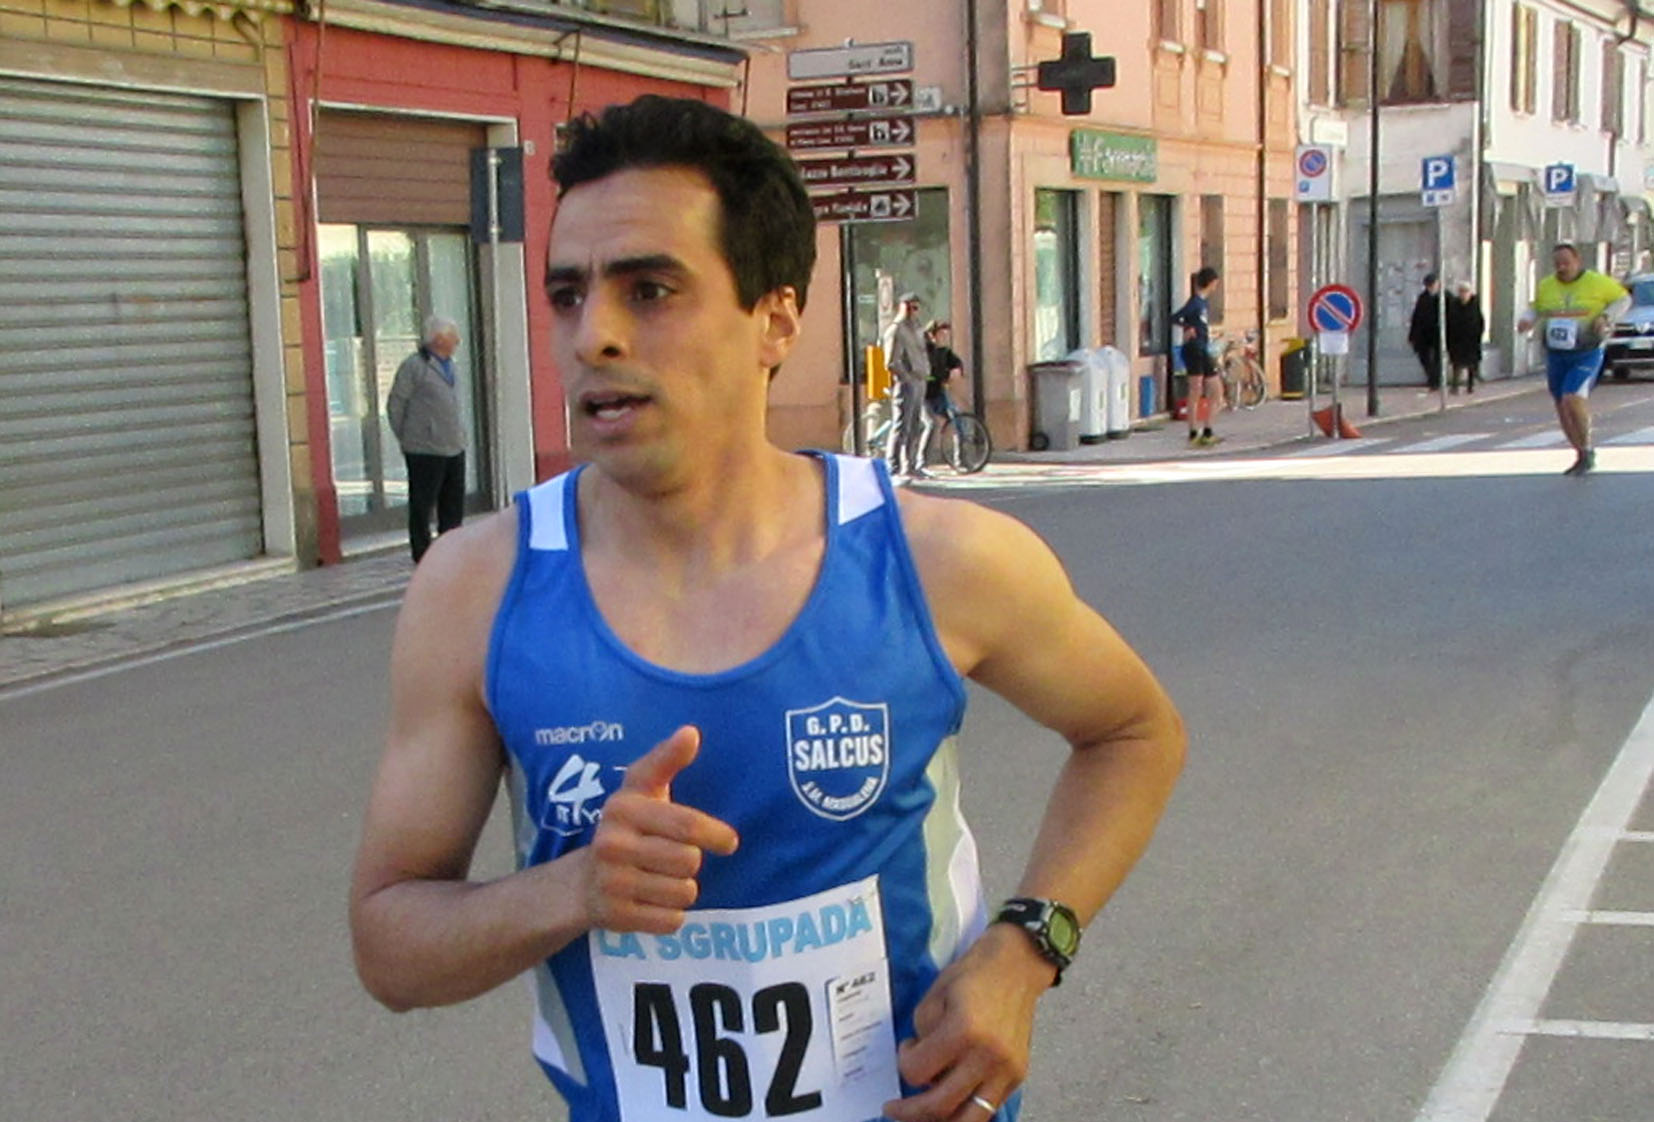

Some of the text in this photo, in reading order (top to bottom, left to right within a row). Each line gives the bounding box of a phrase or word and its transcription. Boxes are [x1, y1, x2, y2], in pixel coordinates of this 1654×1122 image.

[1428, 160, 1448, 187] P
[1551, 167, 1568, 190] P
[535, 721, 624, 745] macron
[794, 734, 883, 771] SALCUS
[598, 900, 873, 963] LA SGRUPADA
[633, 981, 823, 1118] 462
